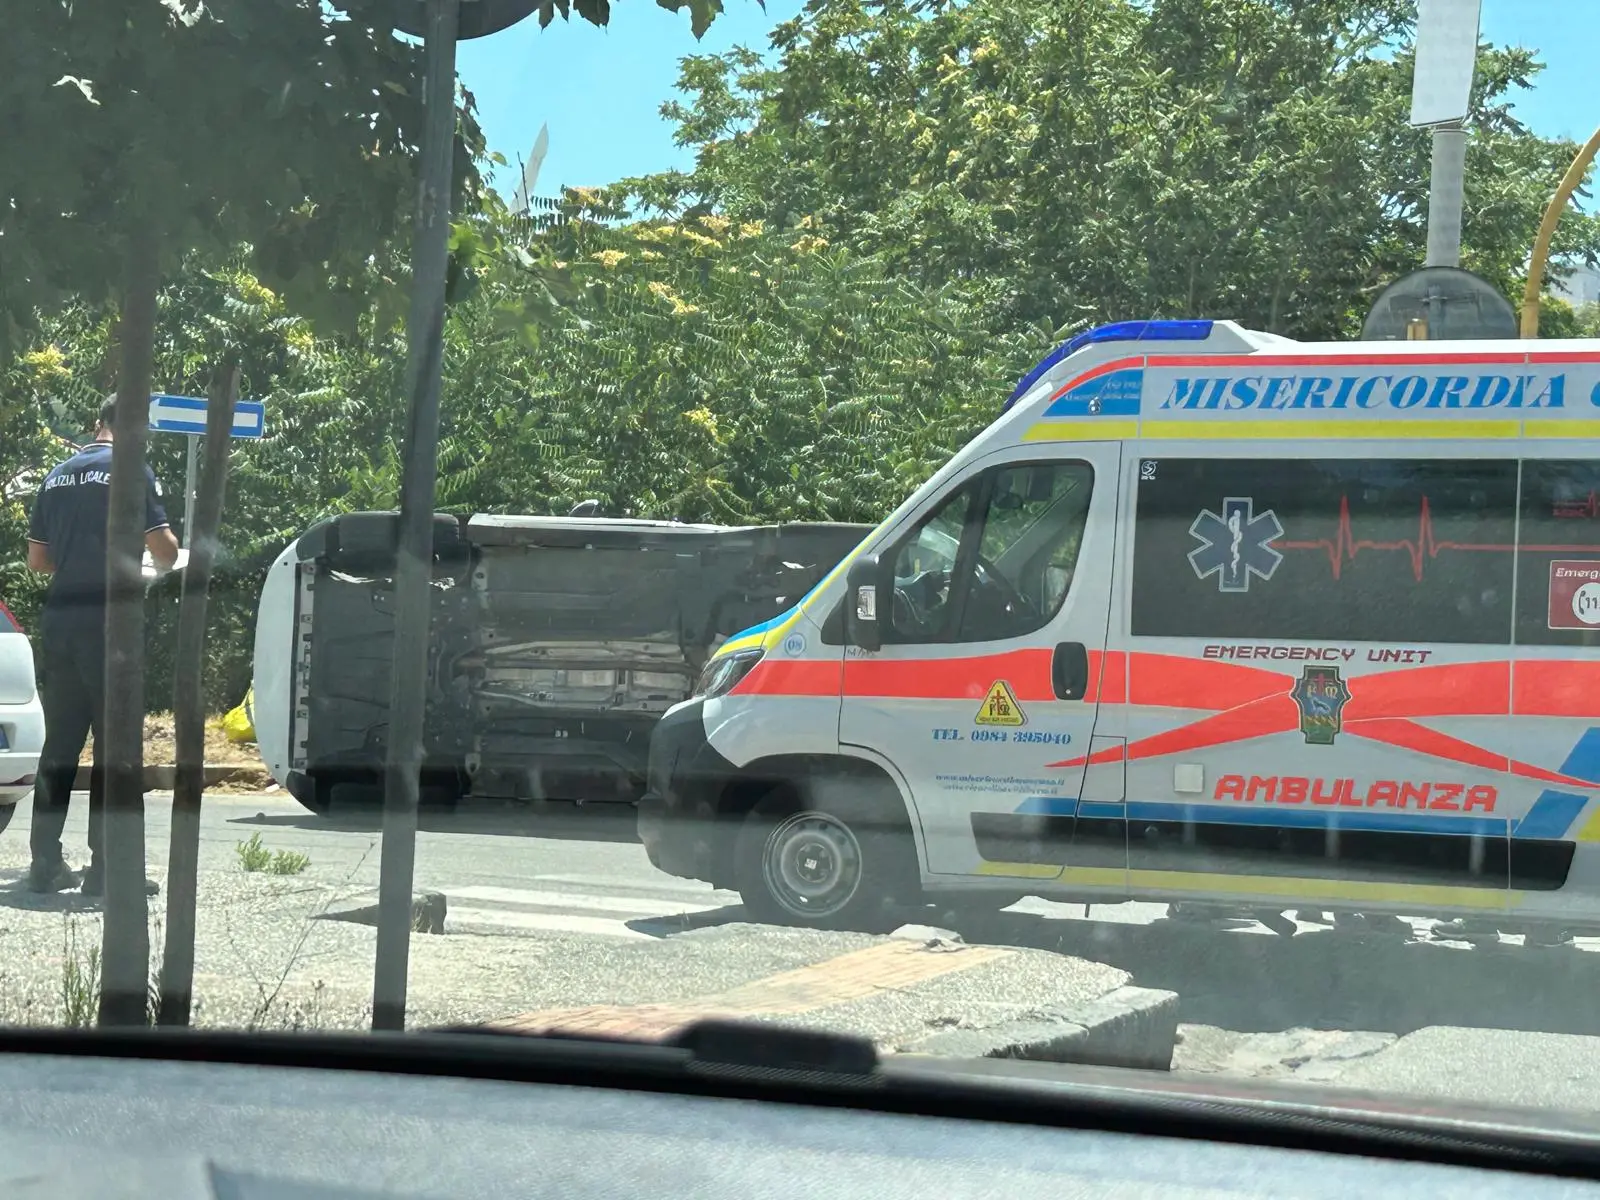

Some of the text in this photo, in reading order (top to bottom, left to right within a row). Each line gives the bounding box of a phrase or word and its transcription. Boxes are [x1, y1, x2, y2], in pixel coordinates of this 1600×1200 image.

[1159, 374, 1565, 411] MISERICORDIA
[45, 474, 75, 491] POLIZIA
[1555, 567, 1600, 579] Emerg
[1585, 597, 1600, 609] 11
[1203, 645, 1432, 663] EMERGENCY UNIT
[1214, 775, 1498, 812] AMBULANZA
